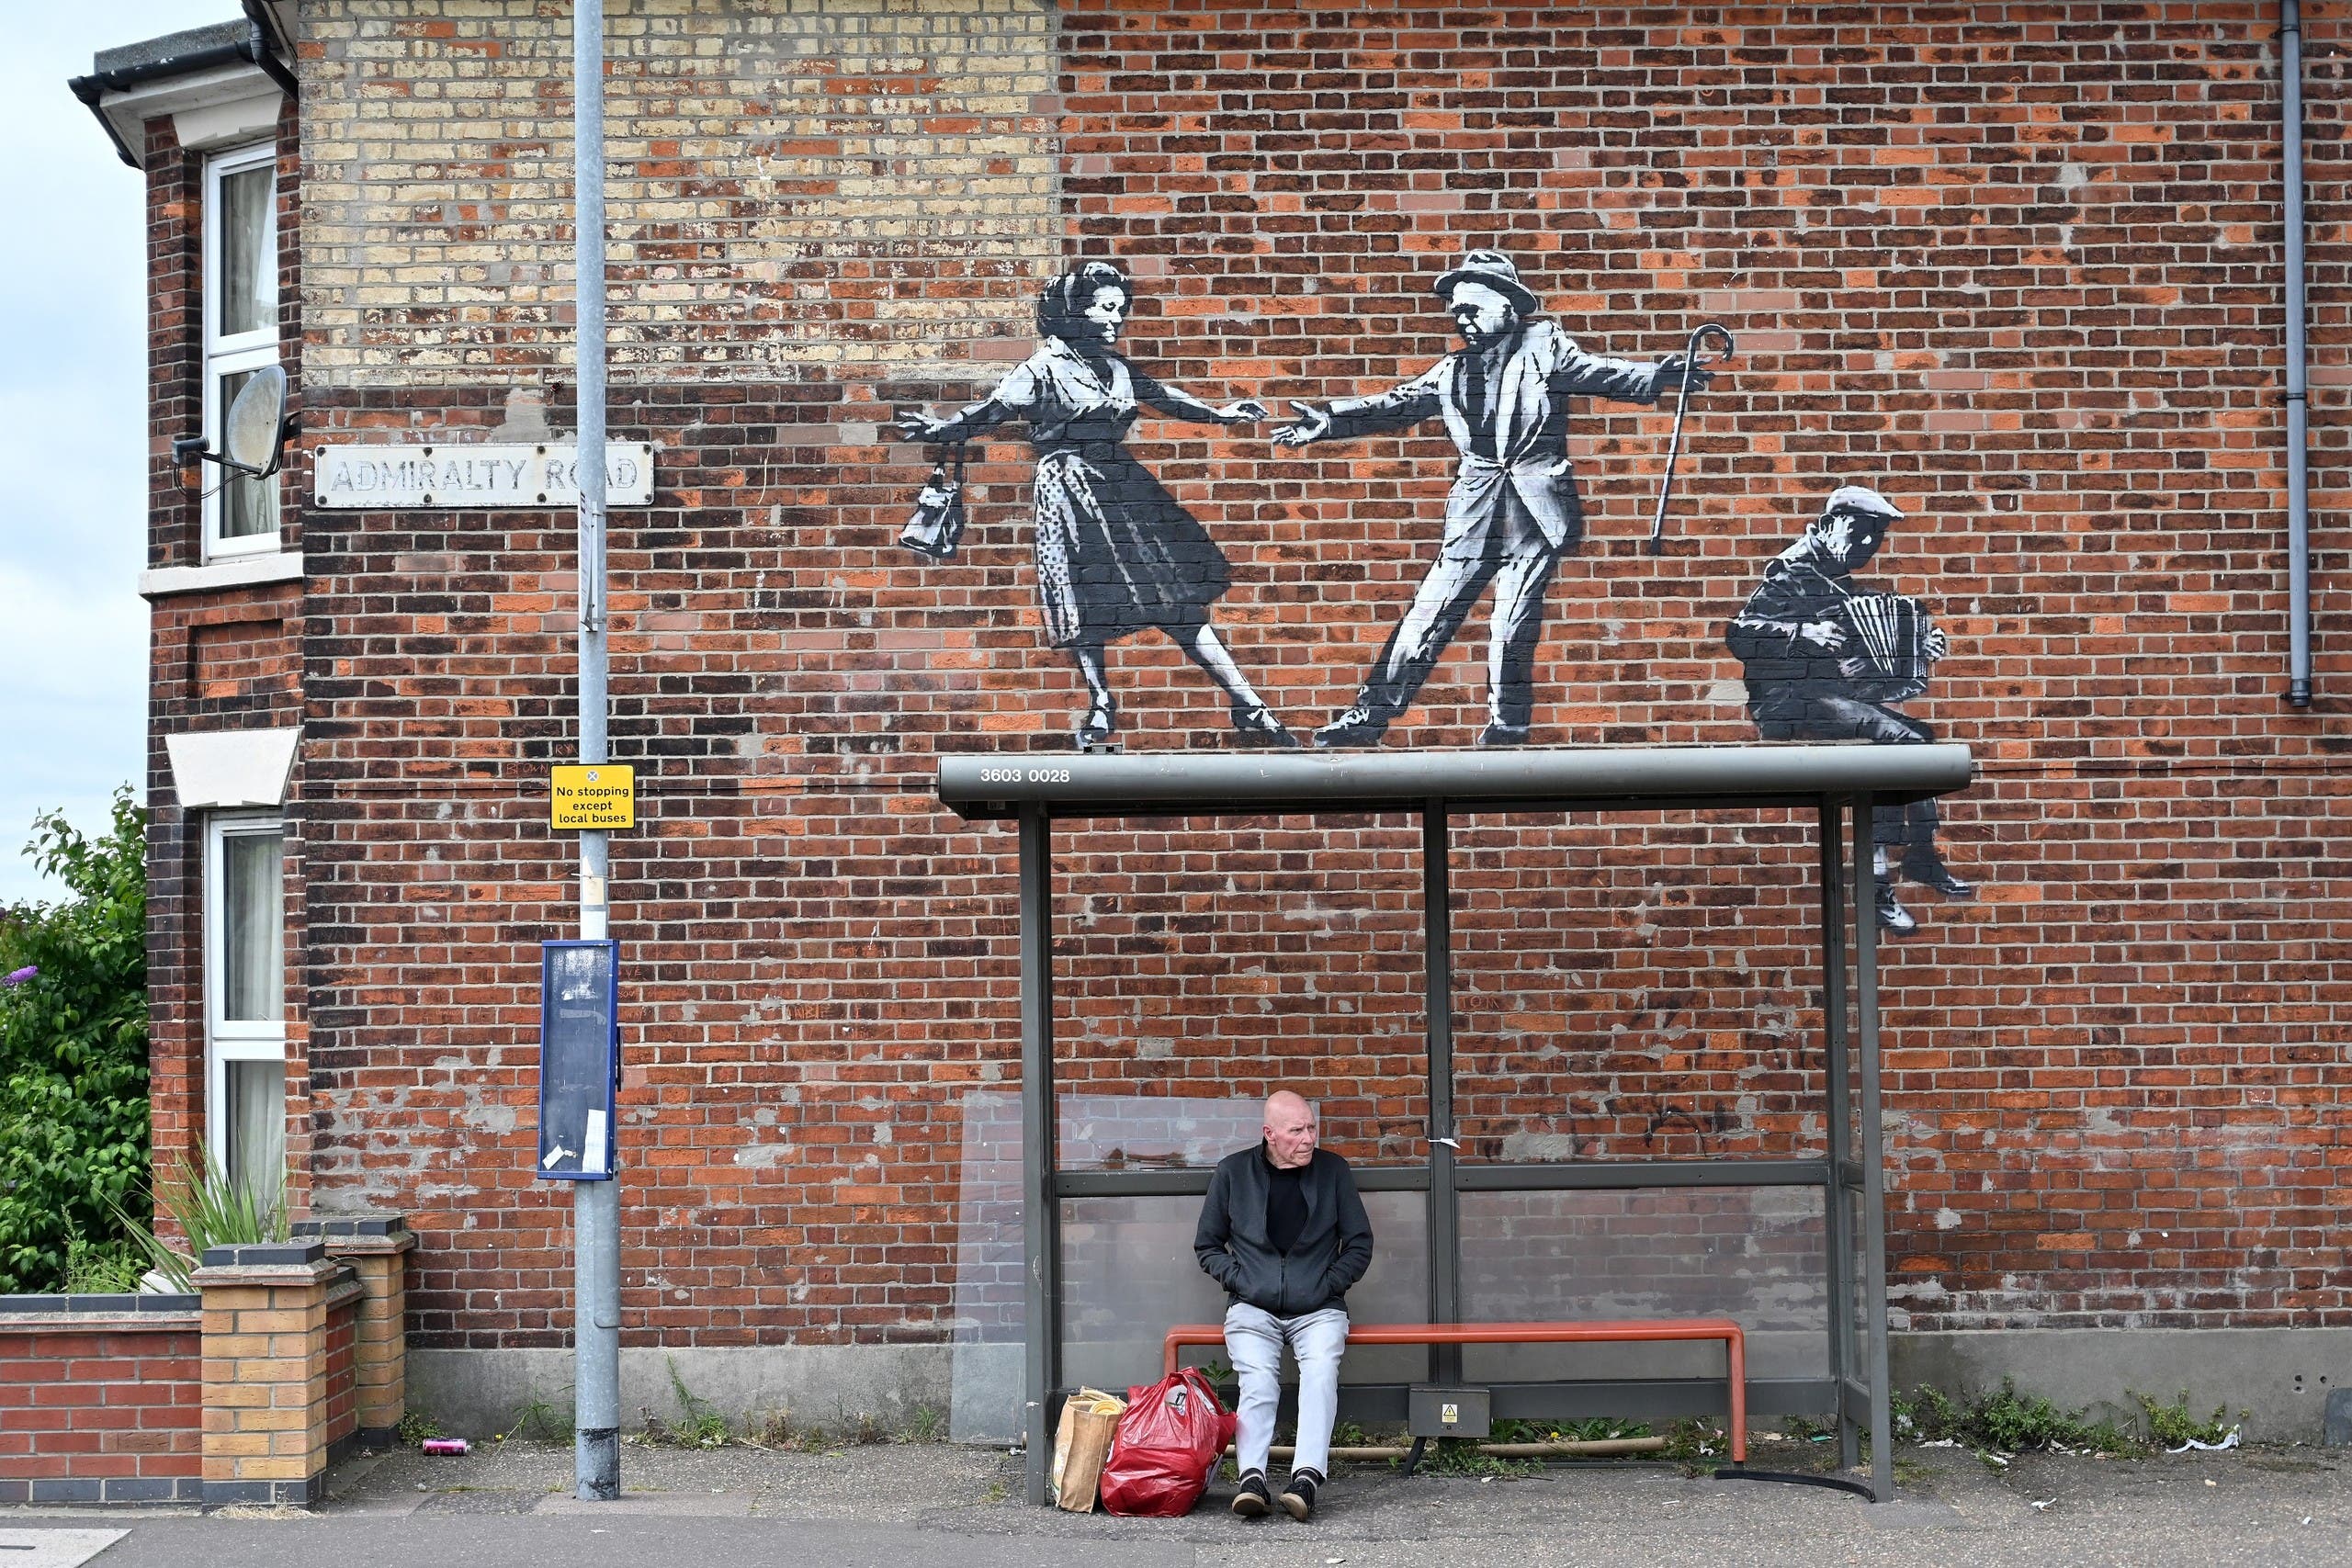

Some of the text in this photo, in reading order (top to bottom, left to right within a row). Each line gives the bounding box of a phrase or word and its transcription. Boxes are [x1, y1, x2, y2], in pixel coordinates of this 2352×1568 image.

[331, 458, 526, 491] ADMIRALTY
[980, 769, 1070, 783] 3603 0028
[557, 786, 629, 797] No stopping
[572, 801, 613, 811] except
[560, 814, 627, 823] local buses
[1459, 996, 1499, 1009] TOM
